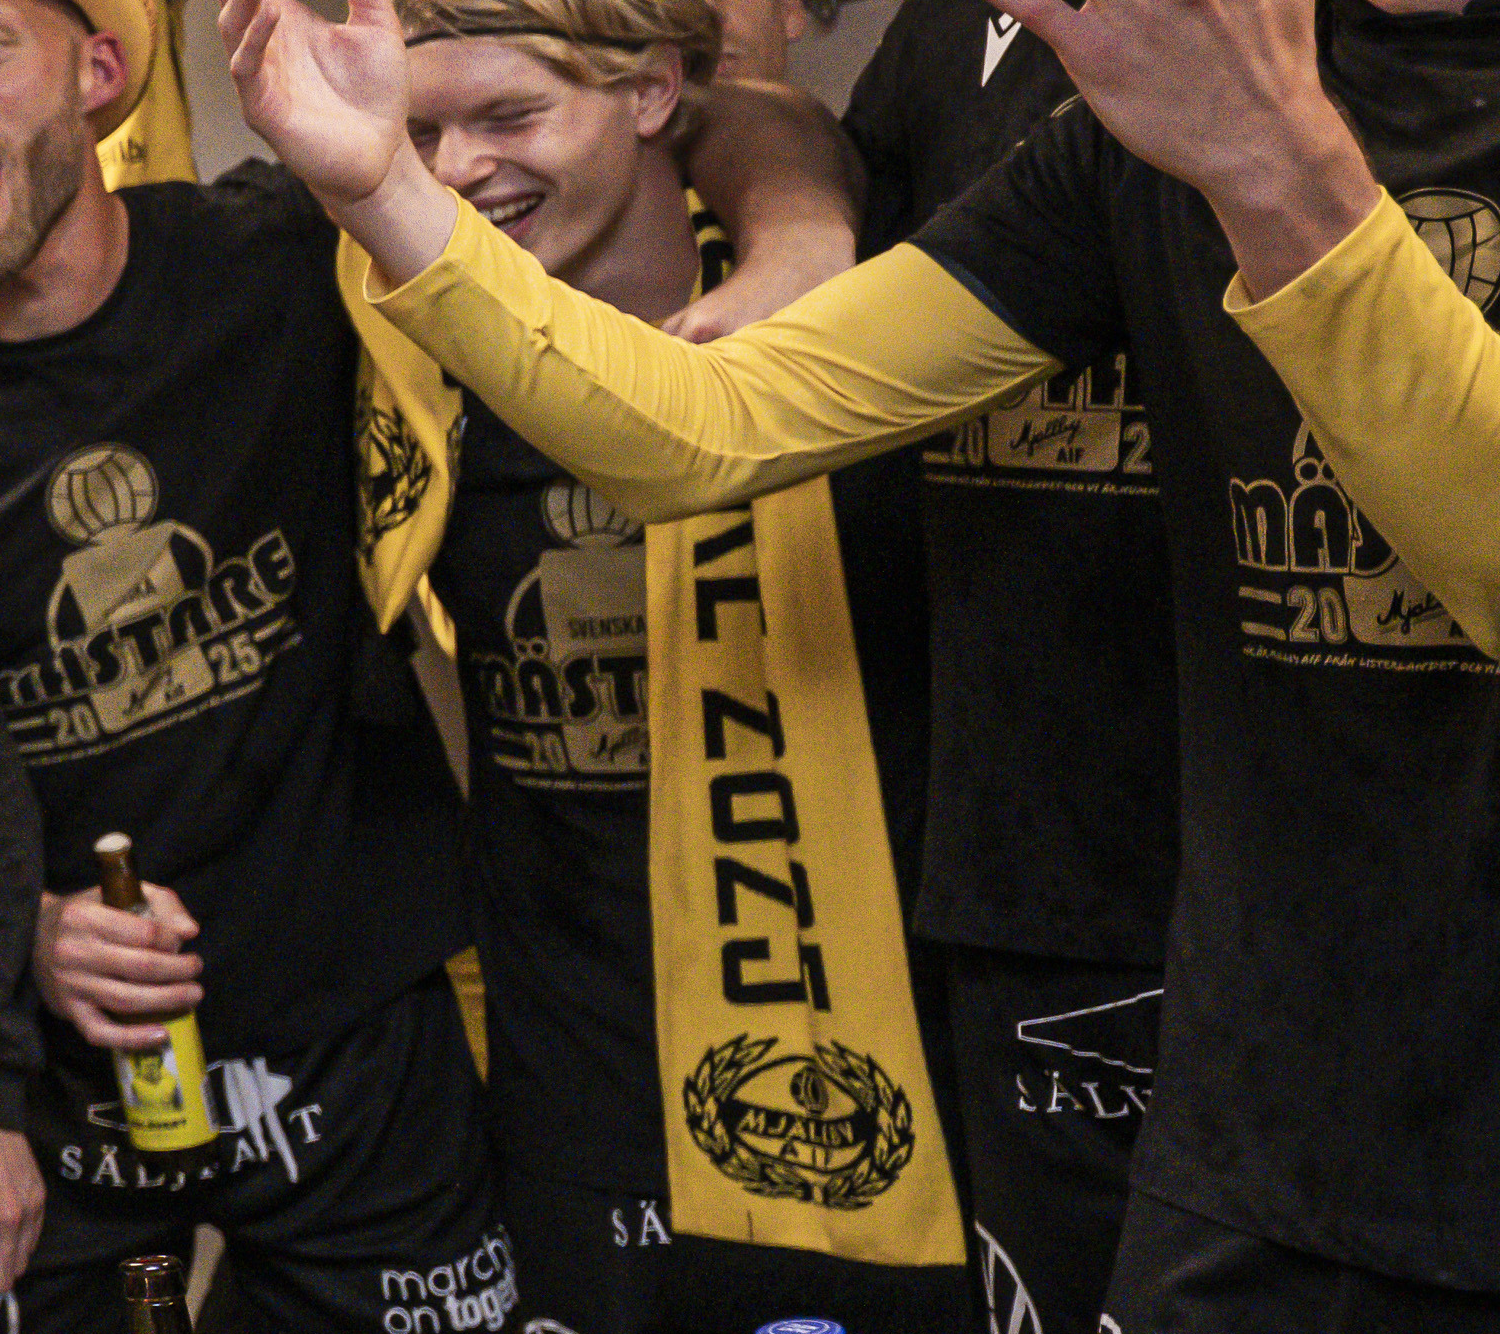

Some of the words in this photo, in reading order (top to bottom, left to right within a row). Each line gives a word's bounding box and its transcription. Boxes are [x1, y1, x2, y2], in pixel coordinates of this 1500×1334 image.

[1285, 583, 1350, 646] 20
[208, 631, 264, 685] 25
[701, 688, 831, 1012] 2025
